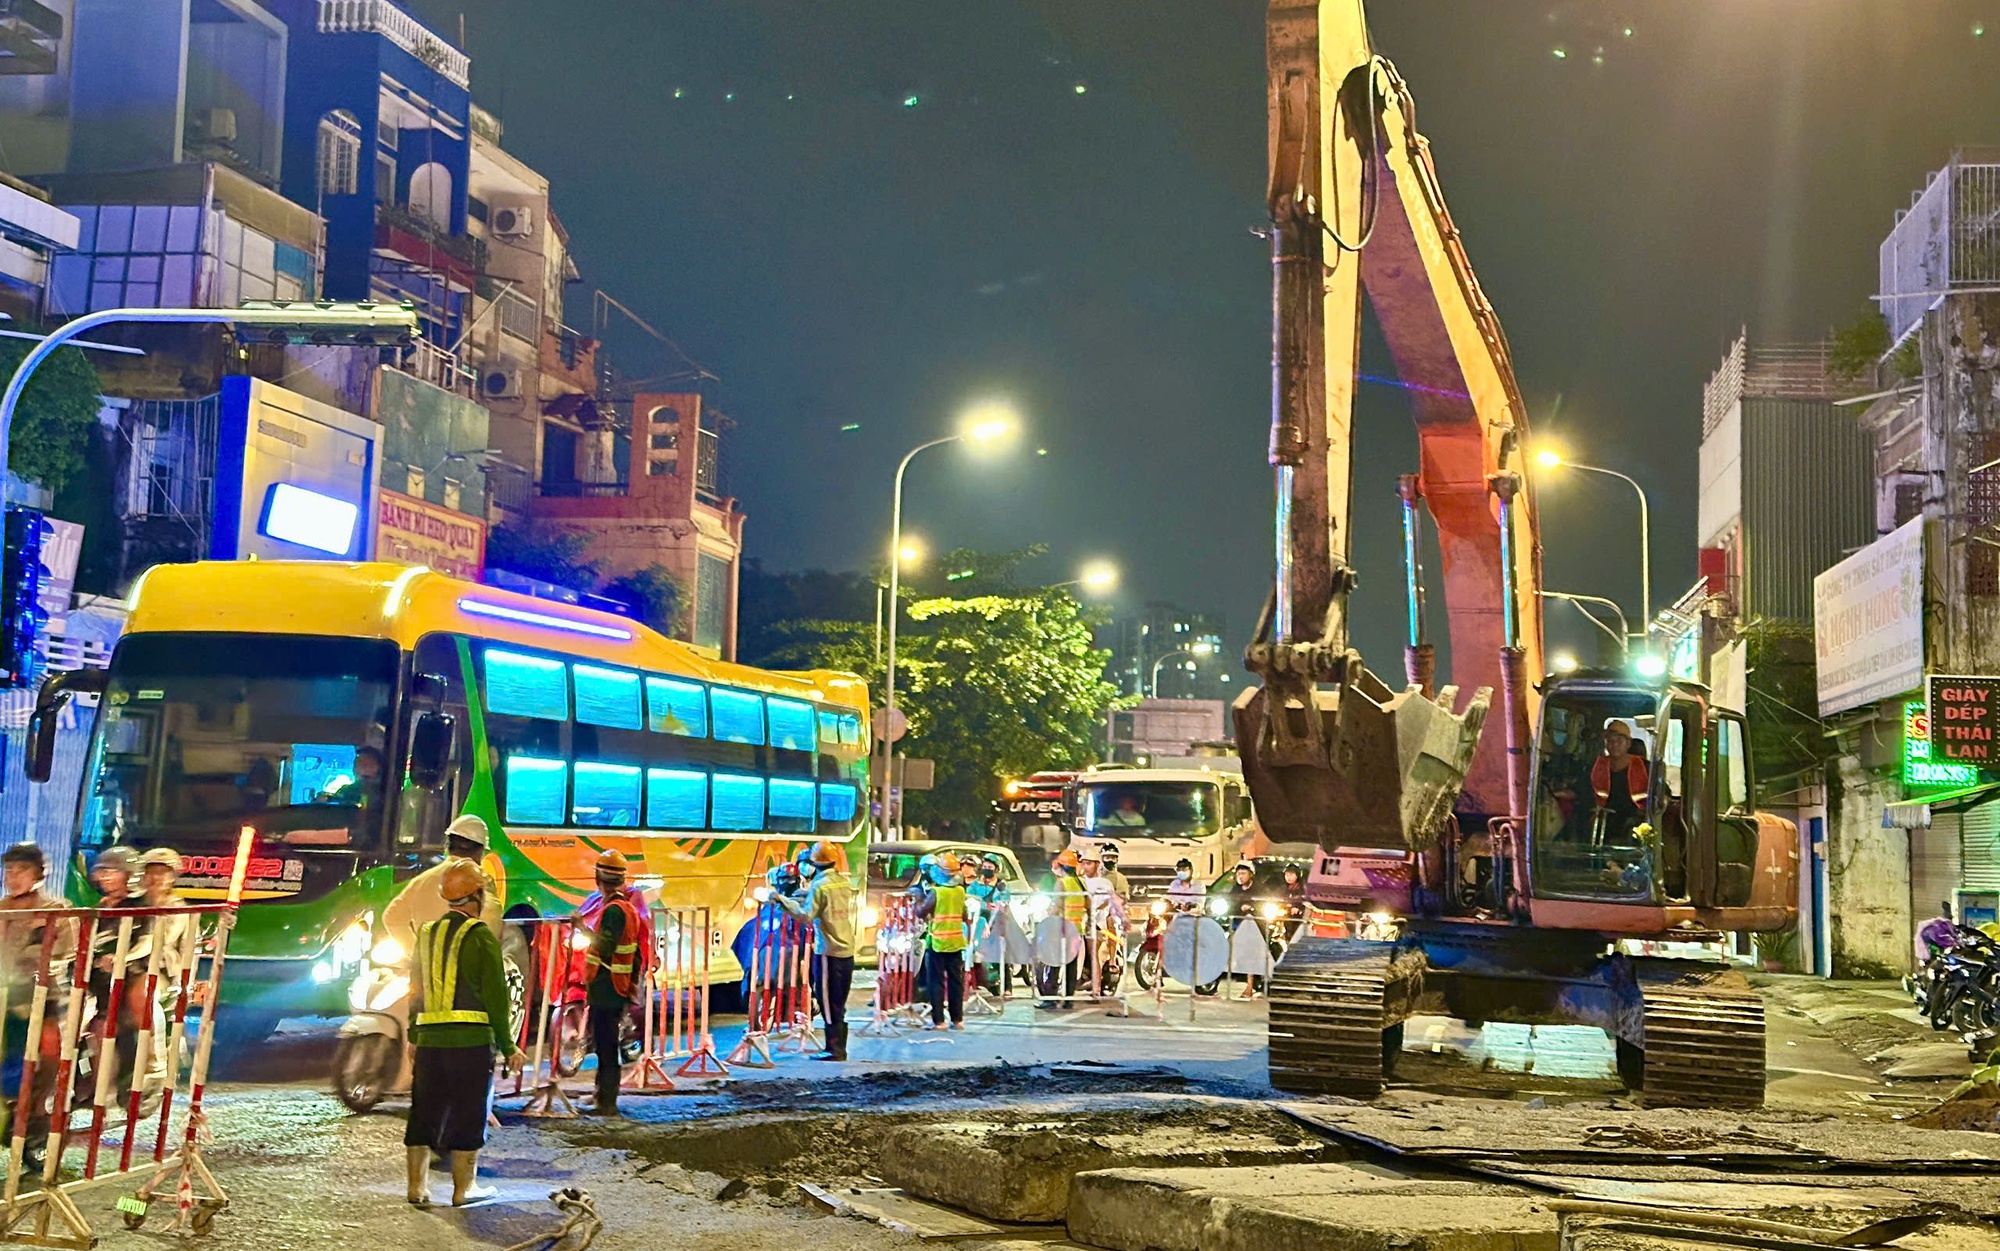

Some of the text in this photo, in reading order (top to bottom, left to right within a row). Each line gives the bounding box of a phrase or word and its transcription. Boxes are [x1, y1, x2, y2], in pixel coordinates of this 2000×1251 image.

[1941, 685, 1989, 702] GIÀY
[1945, 704, 1988, 720] DÉP
[1943, 723, 1991, 740] THÁI
[1945, 744, 1988, 758] LAN
